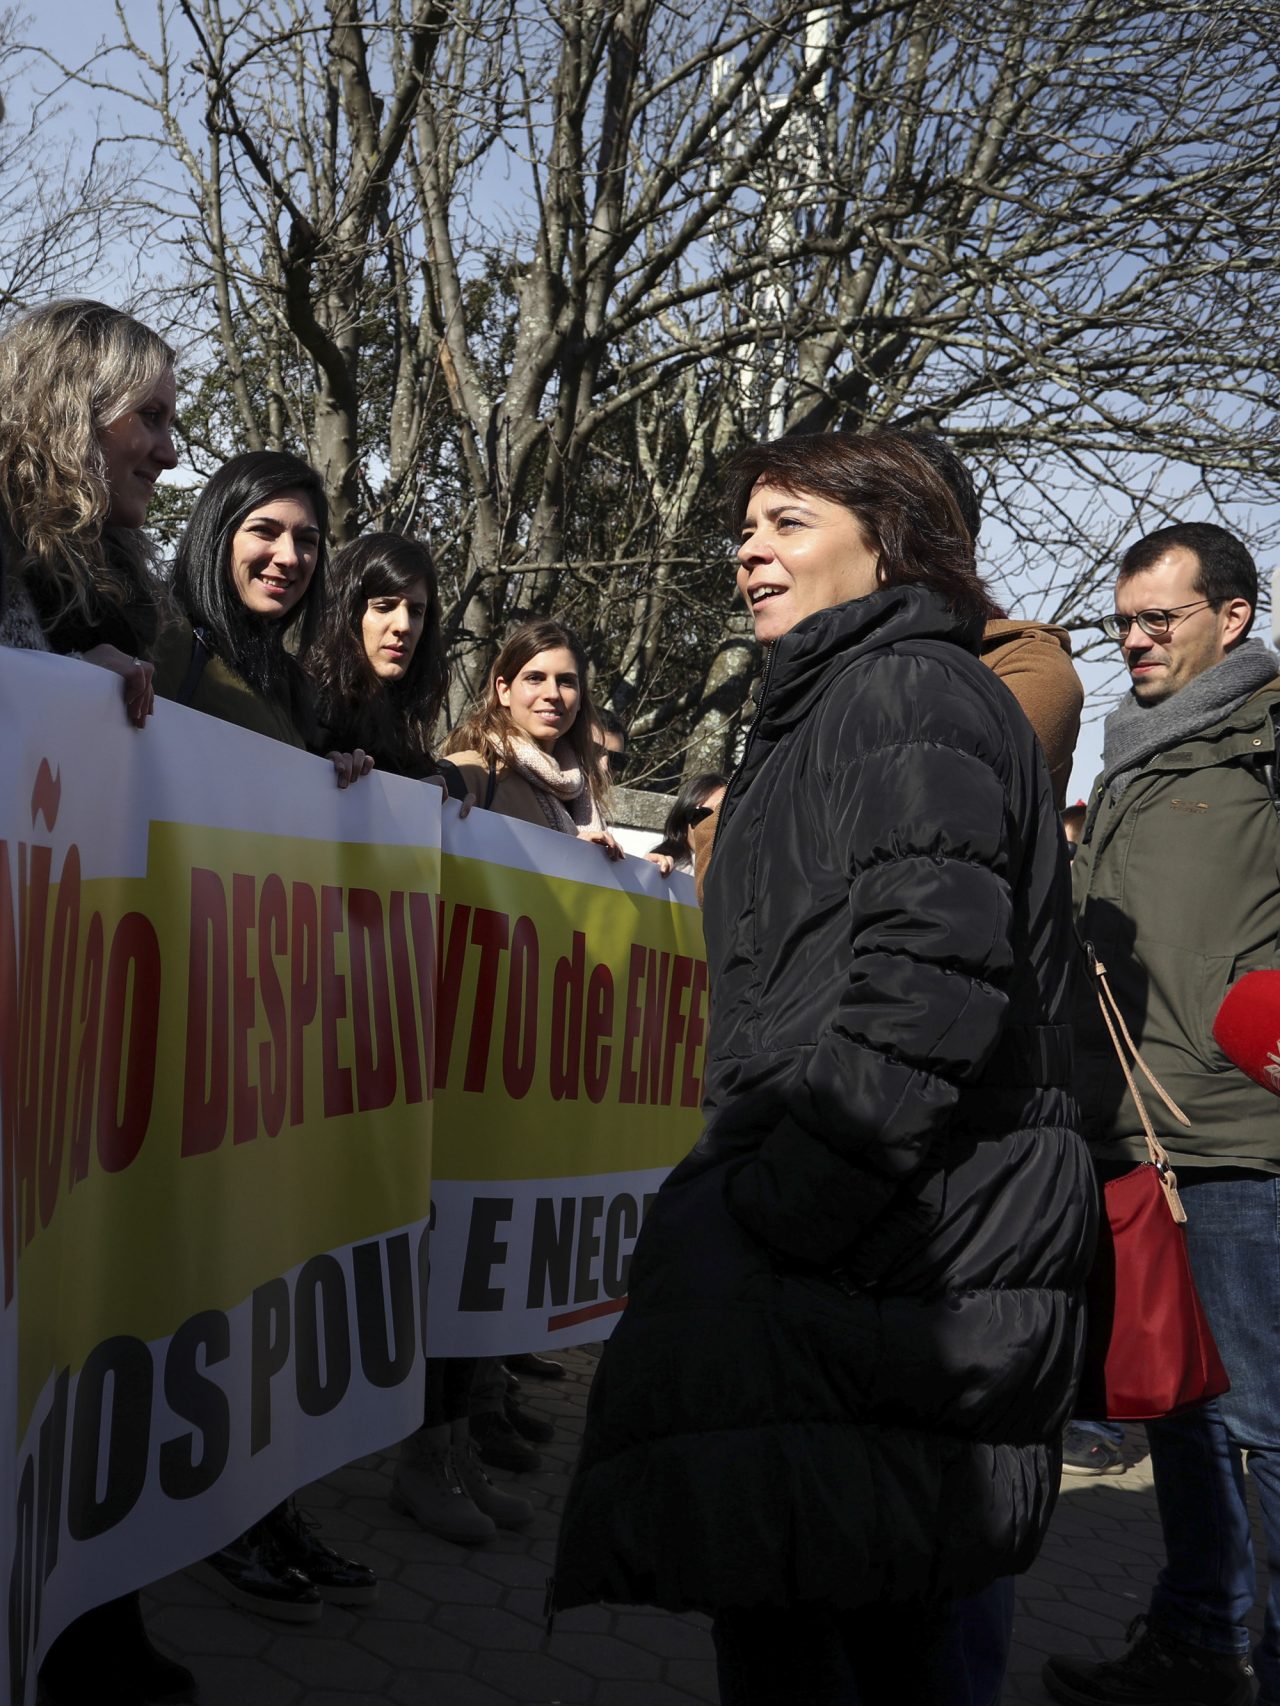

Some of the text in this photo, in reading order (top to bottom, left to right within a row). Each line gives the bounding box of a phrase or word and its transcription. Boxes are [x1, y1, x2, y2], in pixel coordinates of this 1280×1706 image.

[549, 930, 615, 1104] de
[618, 943, 710, 1108] ENFE
[458, 1197, 515, 1312] E
[526, 1192, 660, 1310] NEC
